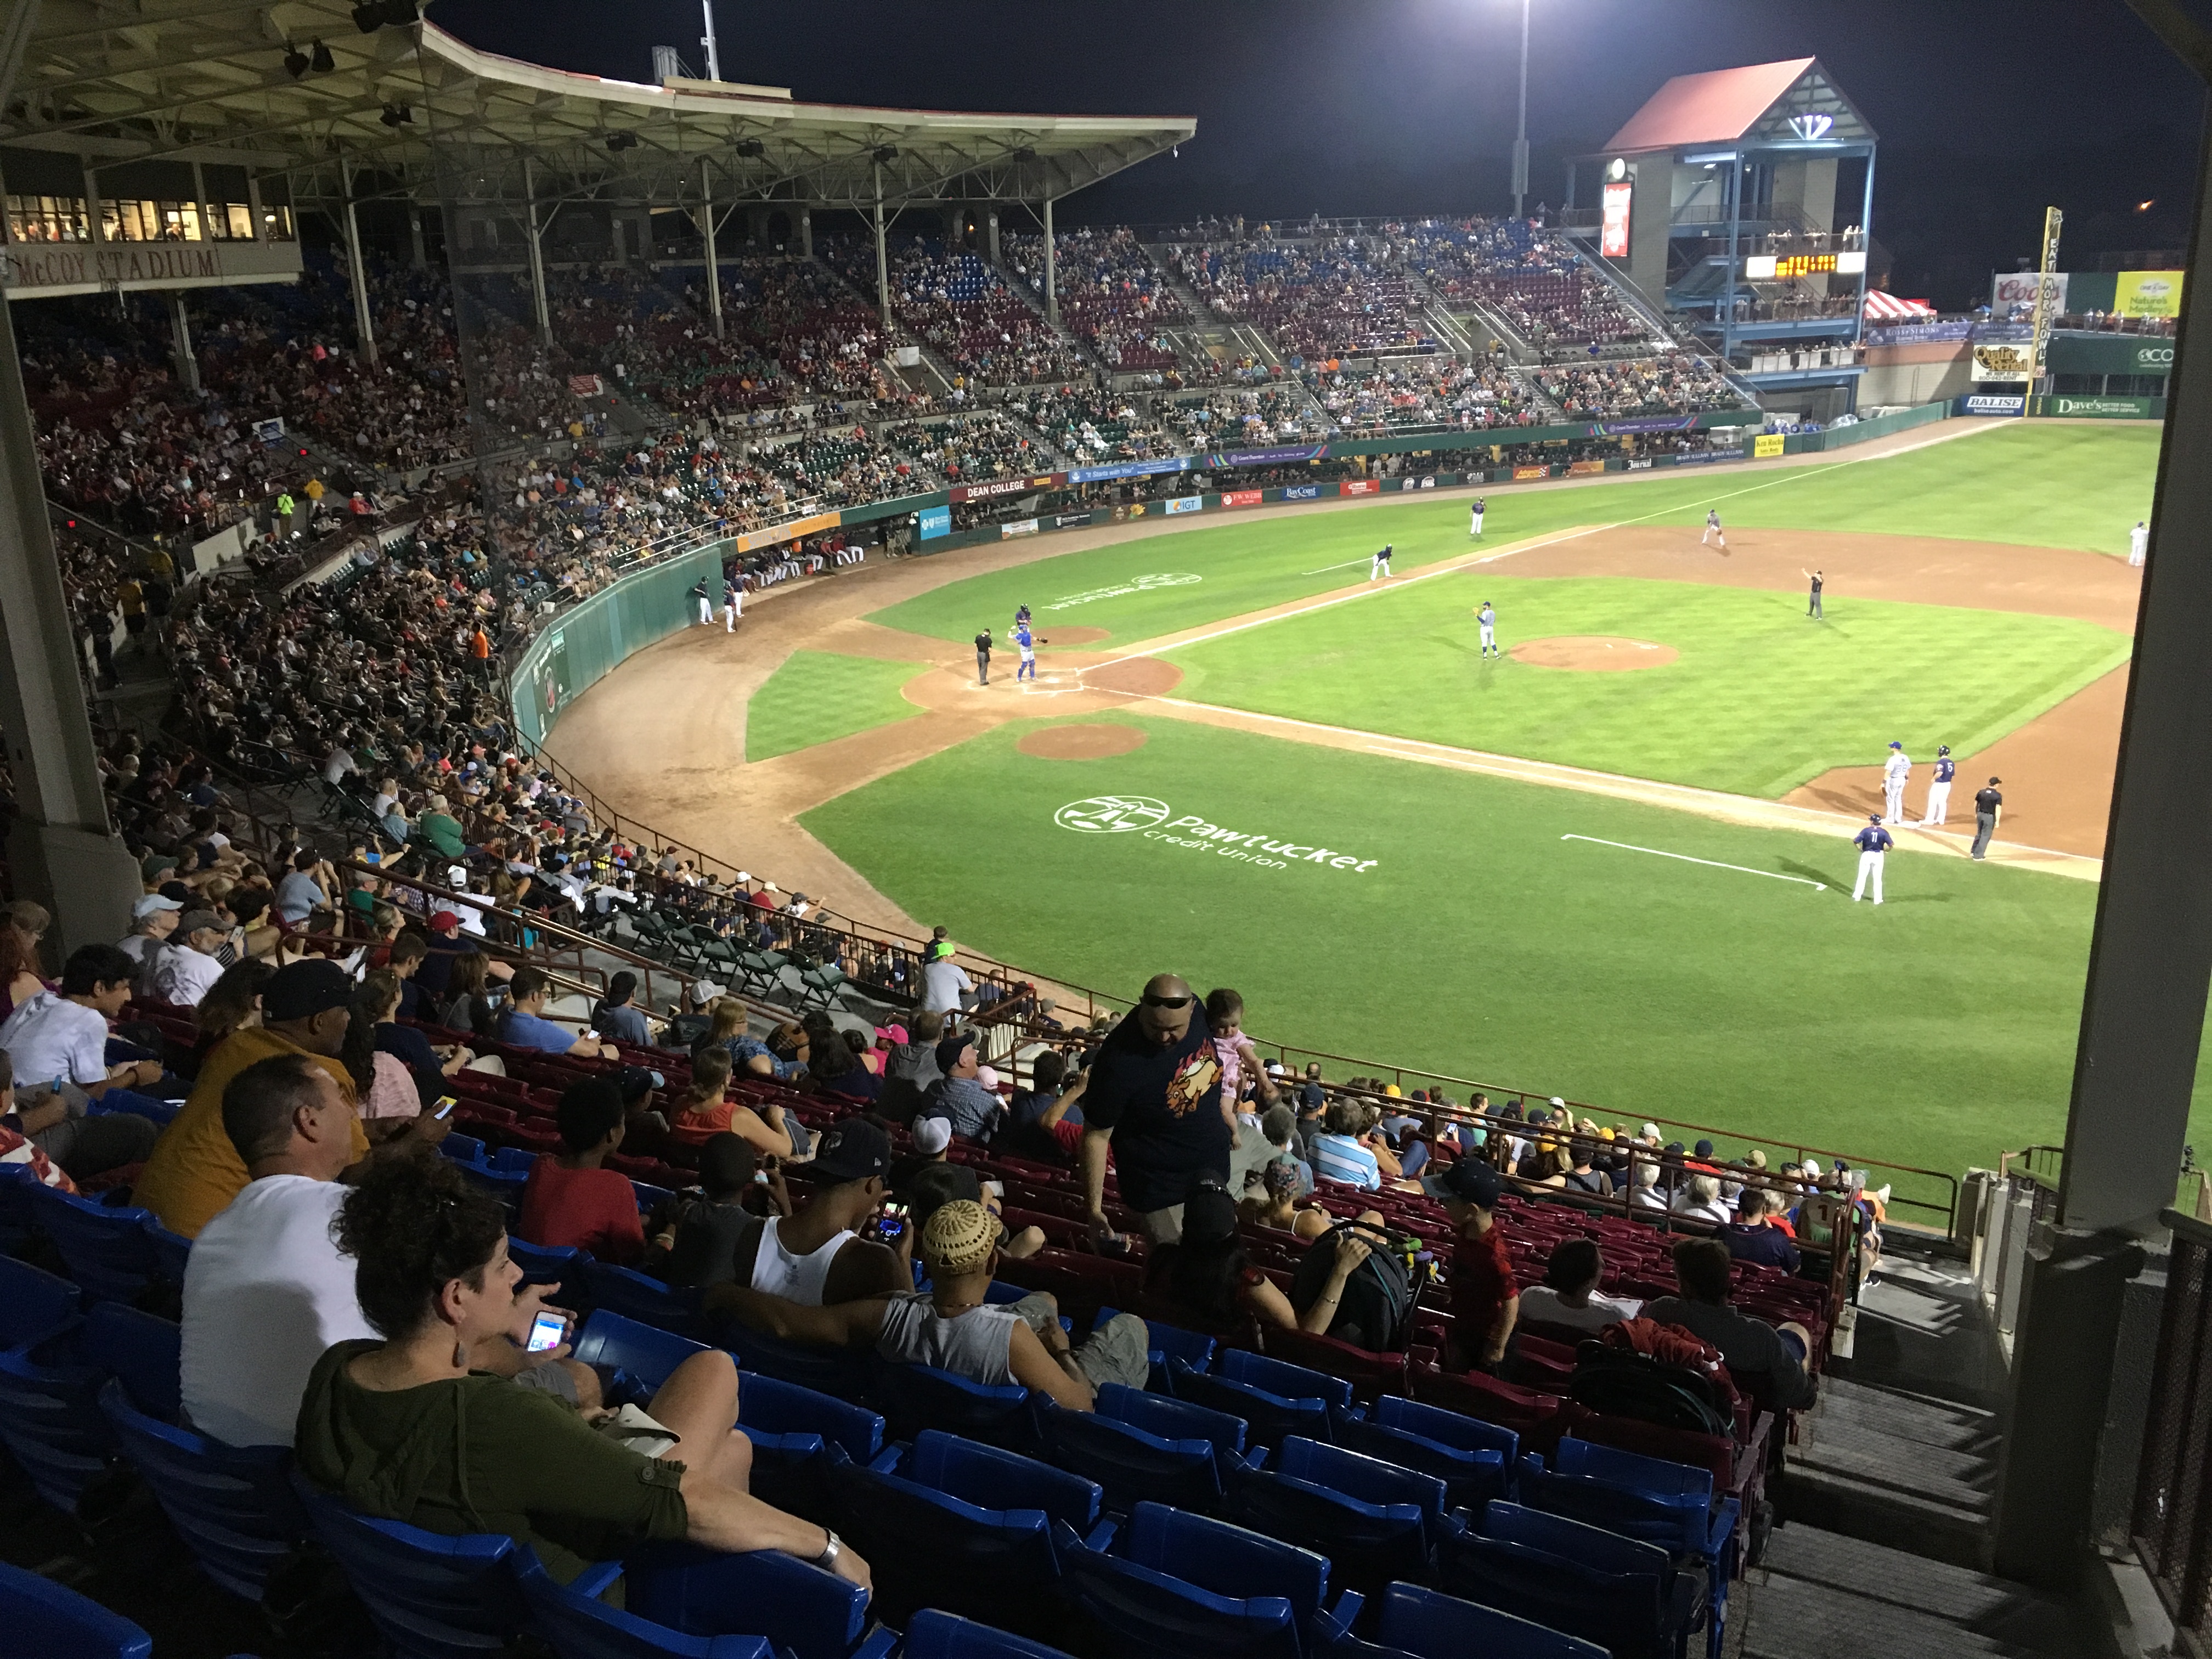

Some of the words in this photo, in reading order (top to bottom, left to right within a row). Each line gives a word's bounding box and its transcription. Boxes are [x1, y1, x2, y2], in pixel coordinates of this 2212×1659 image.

[2047, 238, 2057, 272] EAT
[15, 252, 84, 286] McCOY
[96, 249, 215, 281] STADIUM
[1998, 279, 2061, 301] Coos
[2041, 278, 2054, 311] MOR
[2038, 318, 2049, 361] FOWL
[1974, 346, 2020, 369] Quality
[1989, 358, 2028, 371] Rental
[2057, 399, 2102, 413] Dave's
[1628, 458, 1651, 470] Journal
[967, 486, 989, 498] DEAN
[990, 480, 1025, 494] COLLEGE
[1286, 486, 1316, 495] BayCoast
[1182, 500, 1195, 509] IGT
[1164, 815, 1378, 872] Pawtucket
[1871, 831, 1878, 843] 11
[1143, 831, 1214, 851] credit
[1217, 847, 1287, 869] union
[1818, 1204, 1828, 1221] 1
